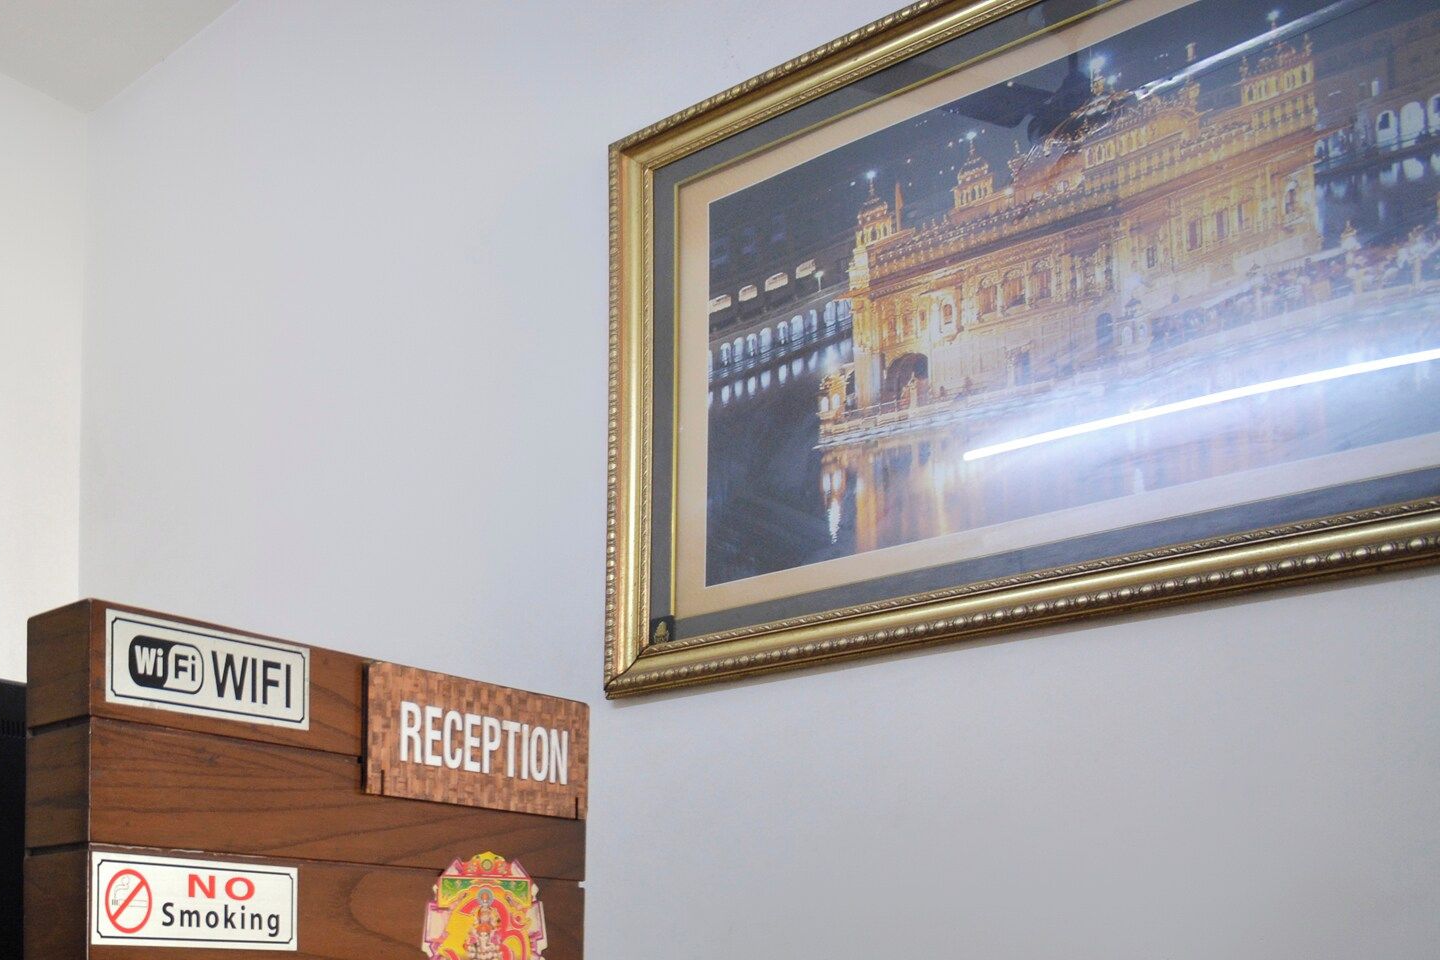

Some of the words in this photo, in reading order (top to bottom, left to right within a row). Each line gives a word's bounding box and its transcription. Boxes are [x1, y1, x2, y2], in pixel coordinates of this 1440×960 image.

[211, 650, 292, 709] WIFI
[399, 701, 569, 786] RECEPTION
[187, 873, 256, 901] NO
[161, 902, 280, 938] Smoking
